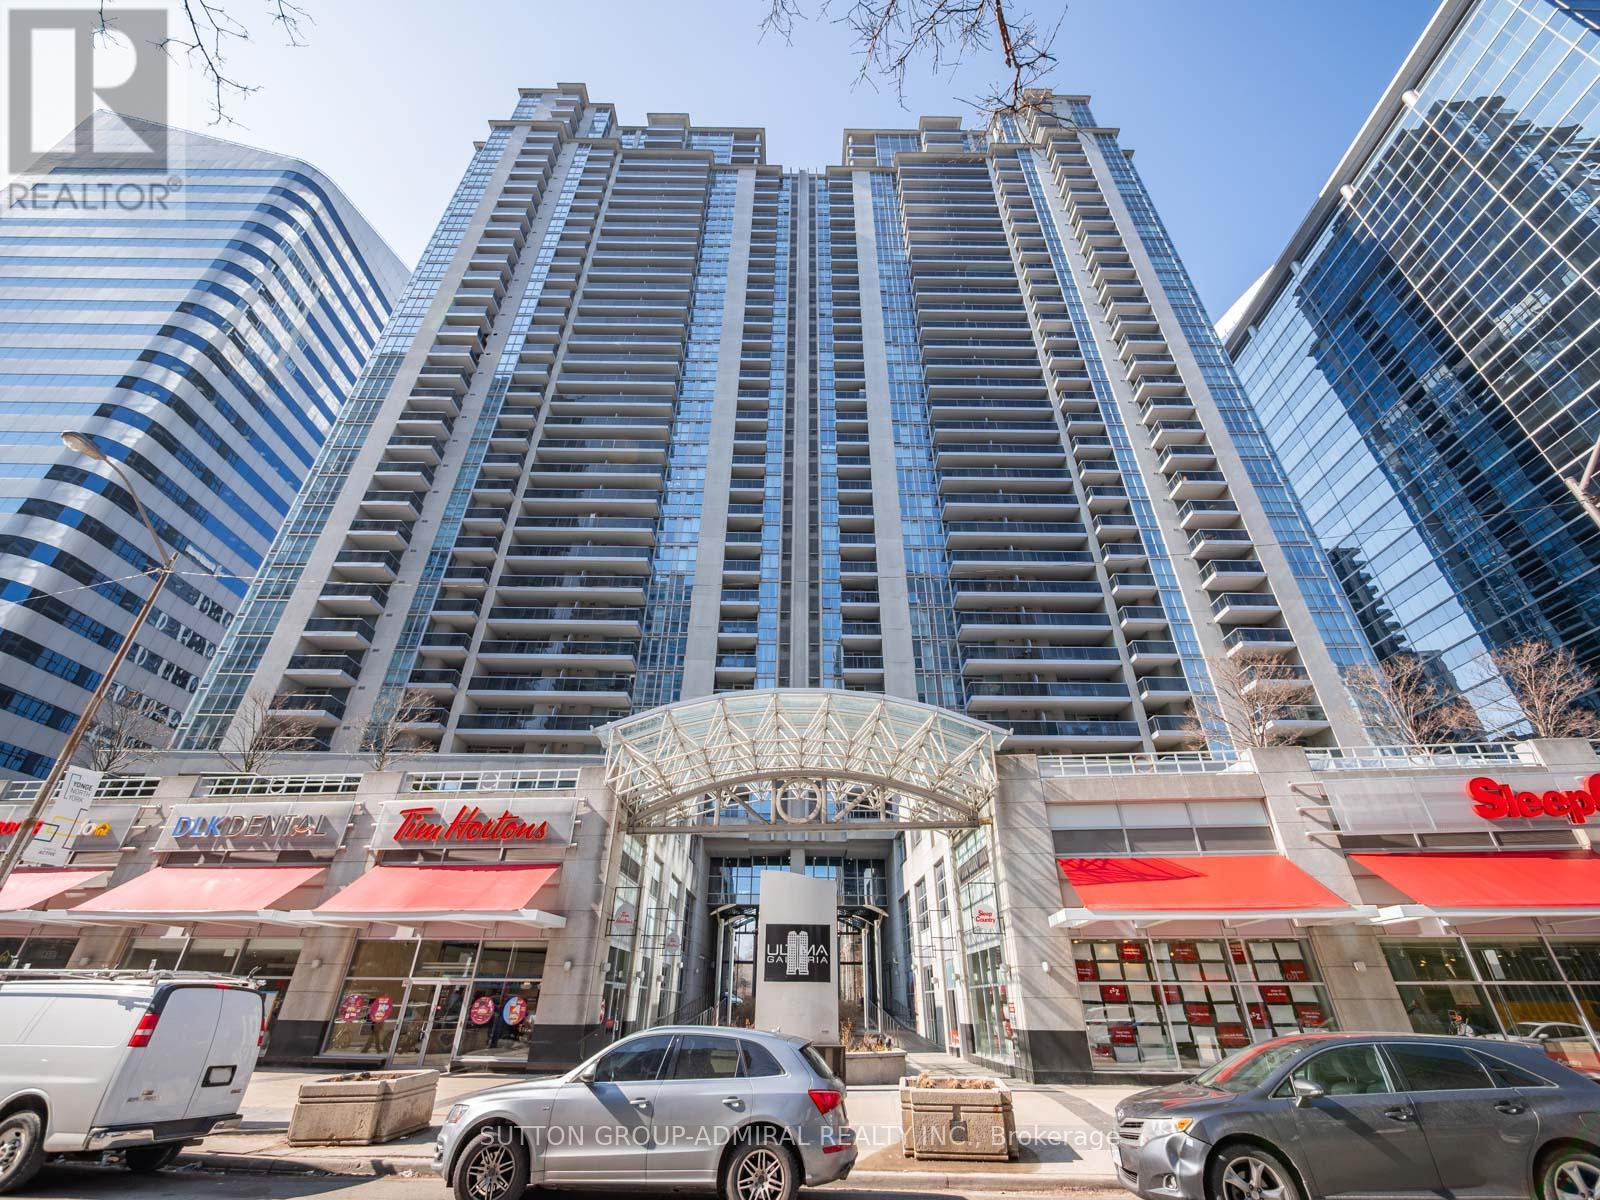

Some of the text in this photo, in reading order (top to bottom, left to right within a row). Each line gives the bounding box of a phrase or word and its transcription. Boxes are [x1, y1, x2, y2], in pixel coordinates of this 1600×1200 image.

[74, 782, 94, 791] YONGE
[70, 788, 91, 798] NORTH
[393, 804, 549, 842] Tim Hortons
[975, 915, 996, 925] Country
